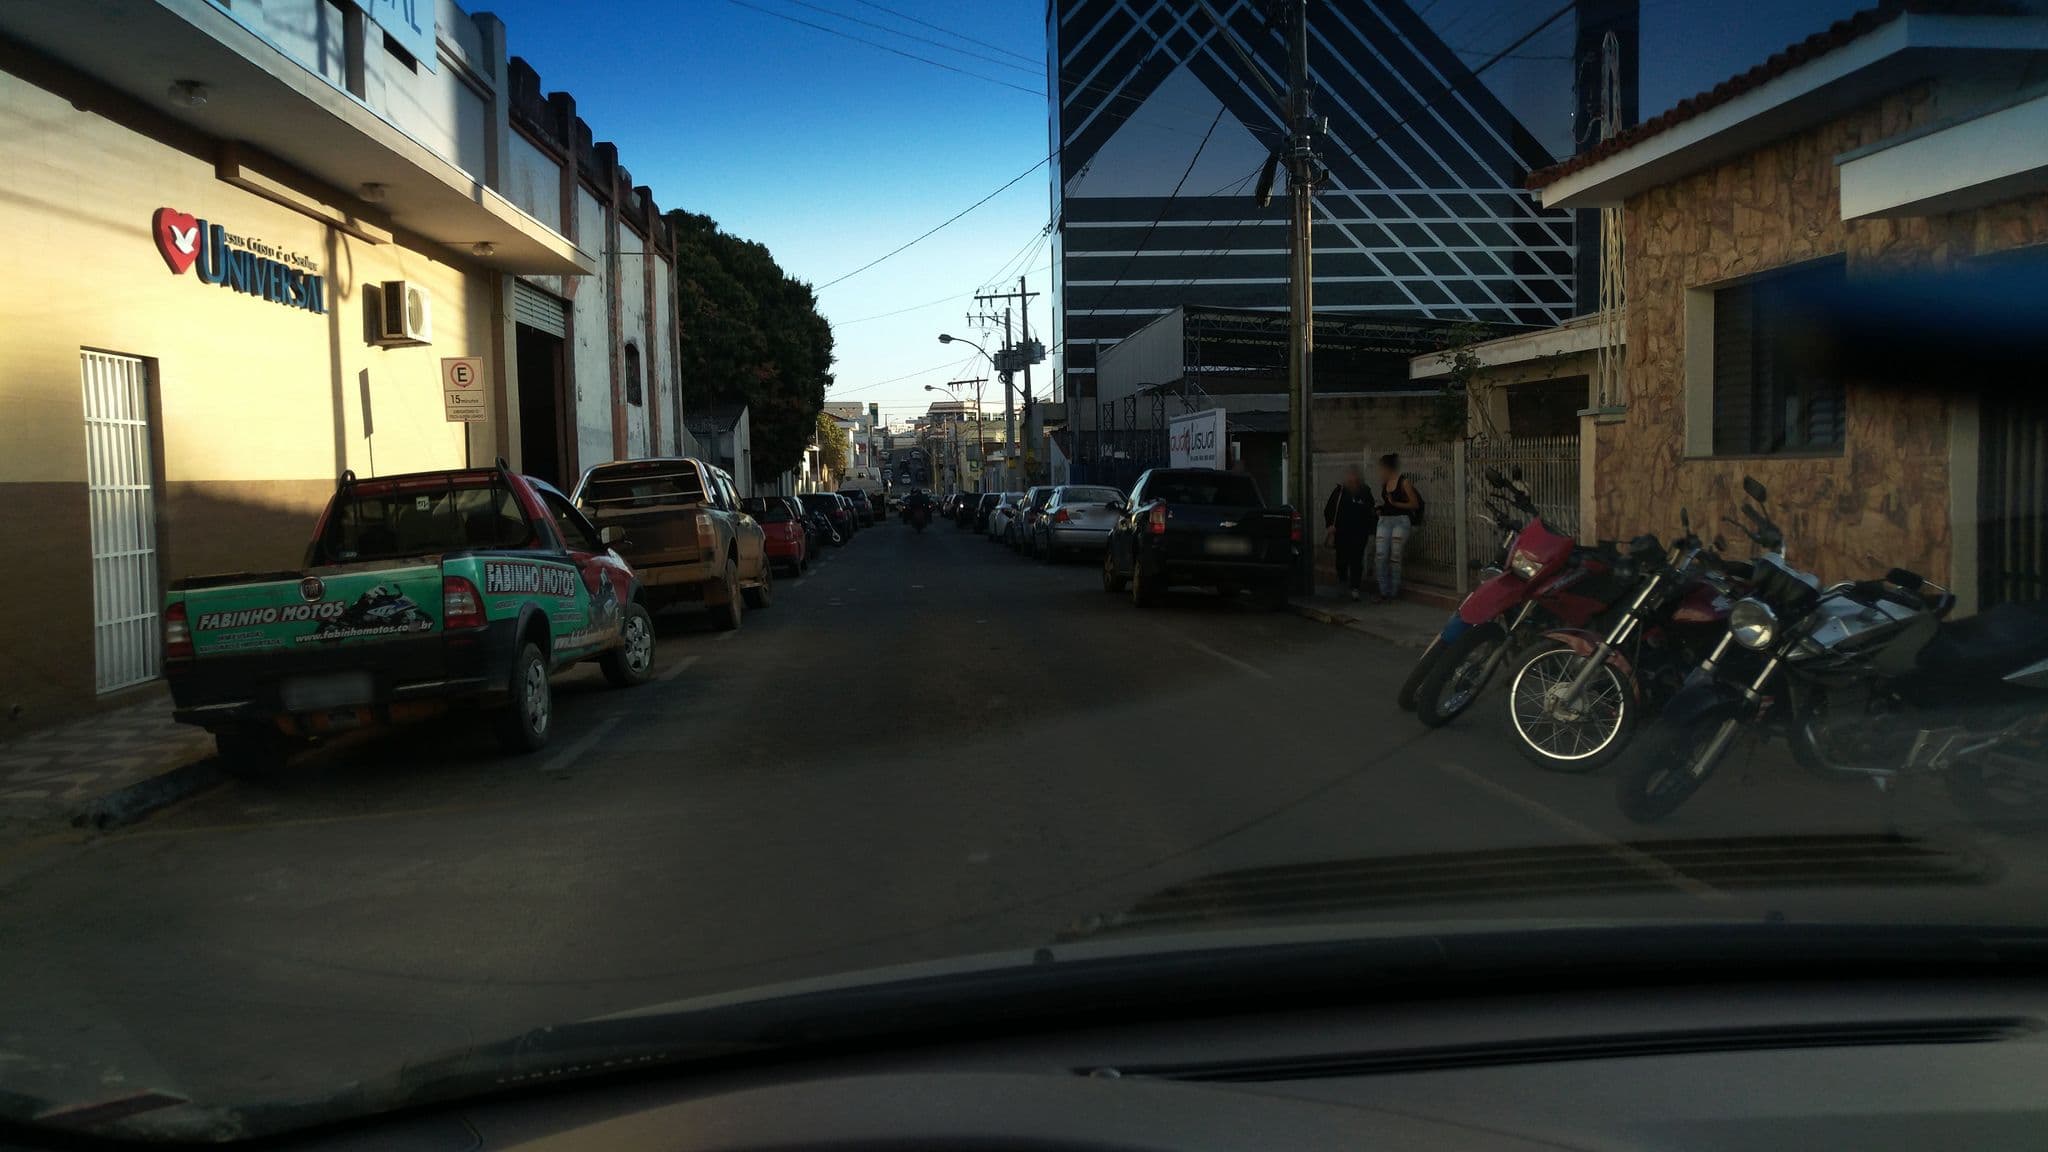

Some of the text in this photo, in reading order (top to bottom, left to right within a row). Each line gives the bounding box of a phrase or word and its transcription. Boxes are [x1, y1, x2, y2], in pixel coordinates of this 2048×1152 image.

[195, 218, 329, 315] UNIVERSAL
[457, 366, 468, 383] E
[450, 394, 461, 405] 15
[486, 563, 576, 597] FABINHO MOTOS
[195, 601, 345, 631] FABINHO MOTOS
